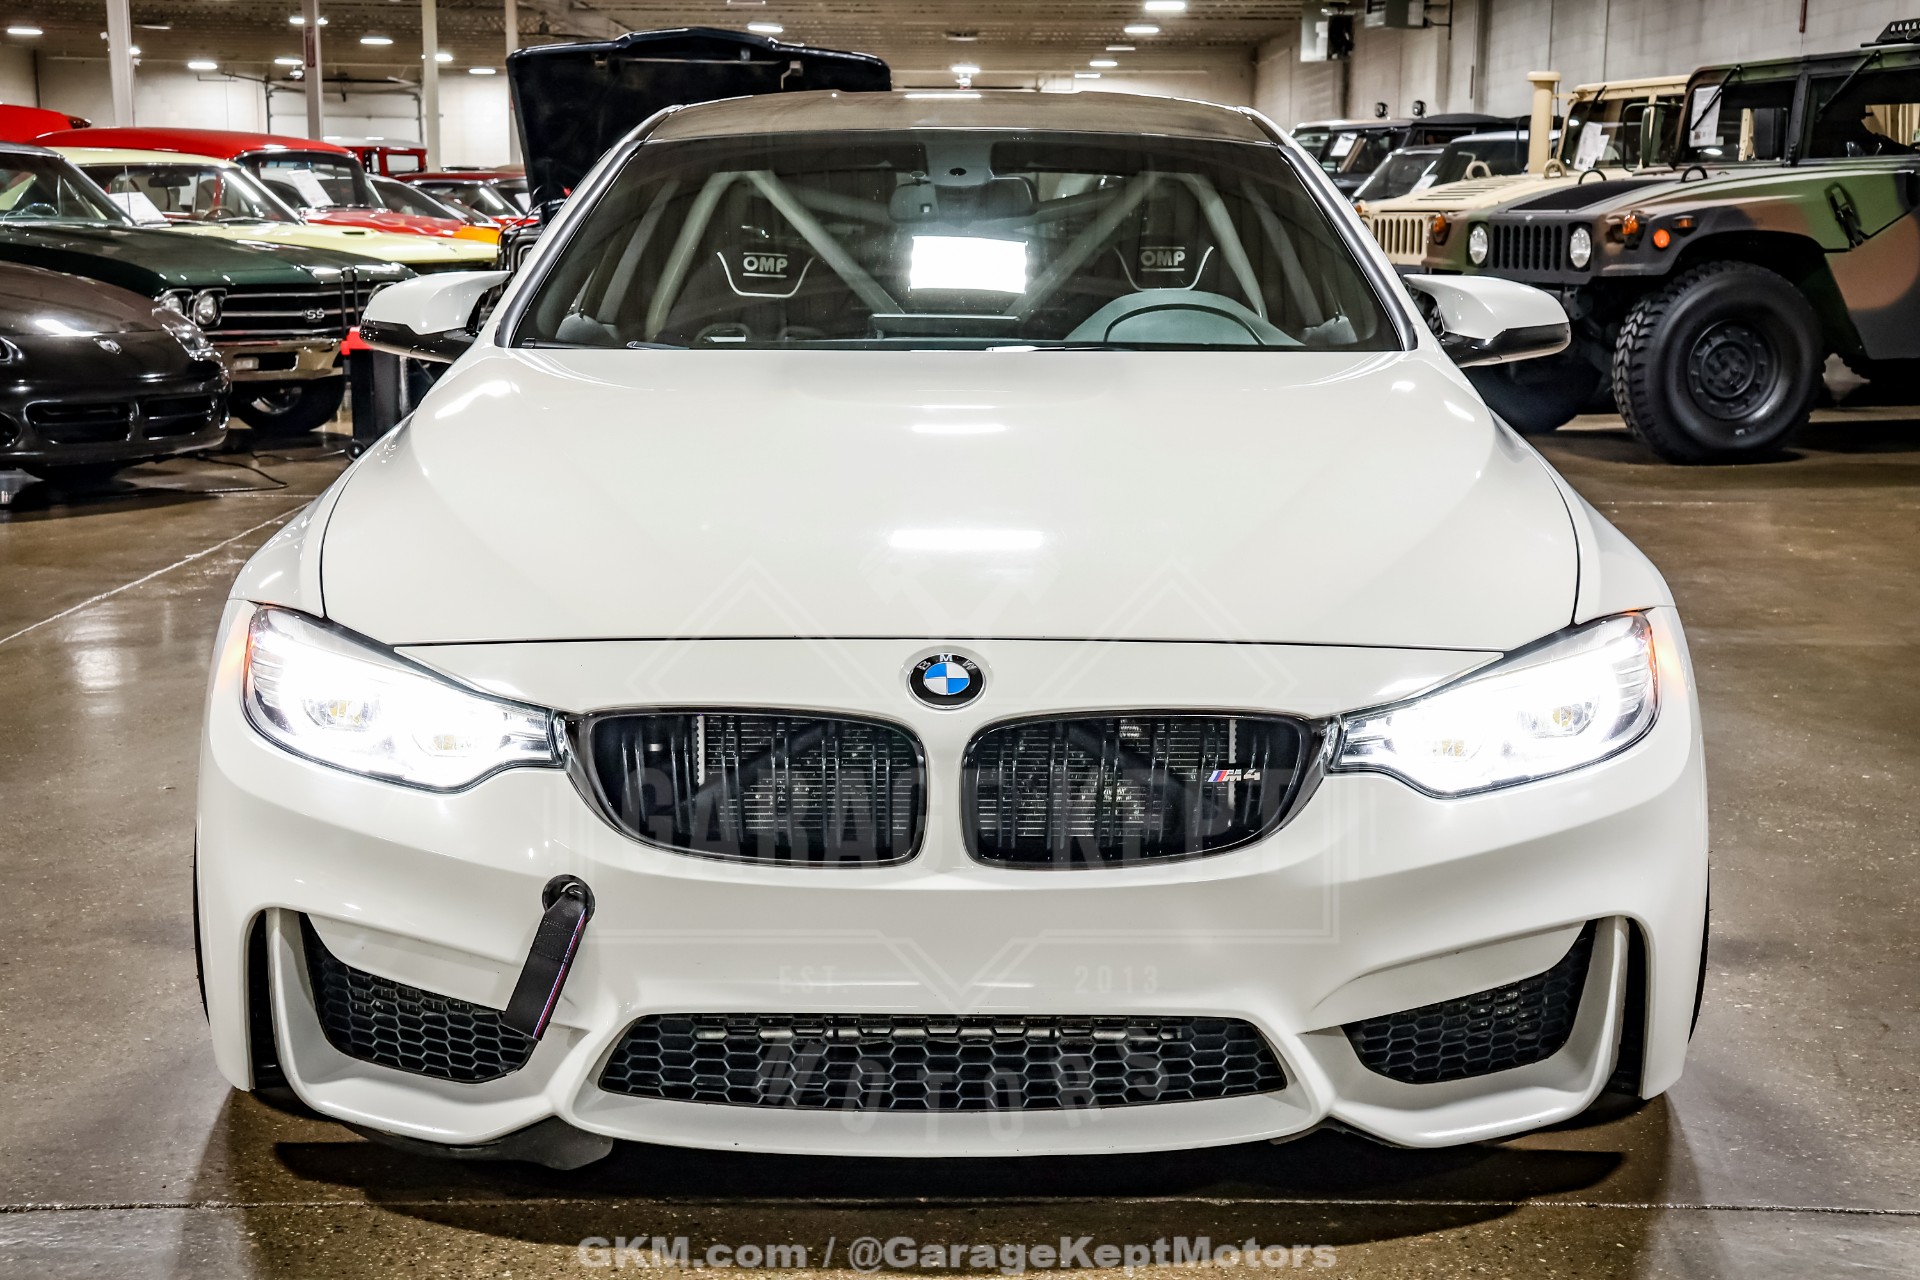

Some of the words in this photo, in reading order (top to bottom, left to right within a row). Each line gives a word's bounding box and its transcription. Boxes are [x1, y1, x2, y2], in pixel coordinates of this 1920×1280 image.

[743, 256, 788, 272] OMP
[1141, 250, 1185, 266] OMP
[307, 308, 325, 319] SS
[916, 654, 978, 671] BMW
[1220, 769, 1260, 781] M4
